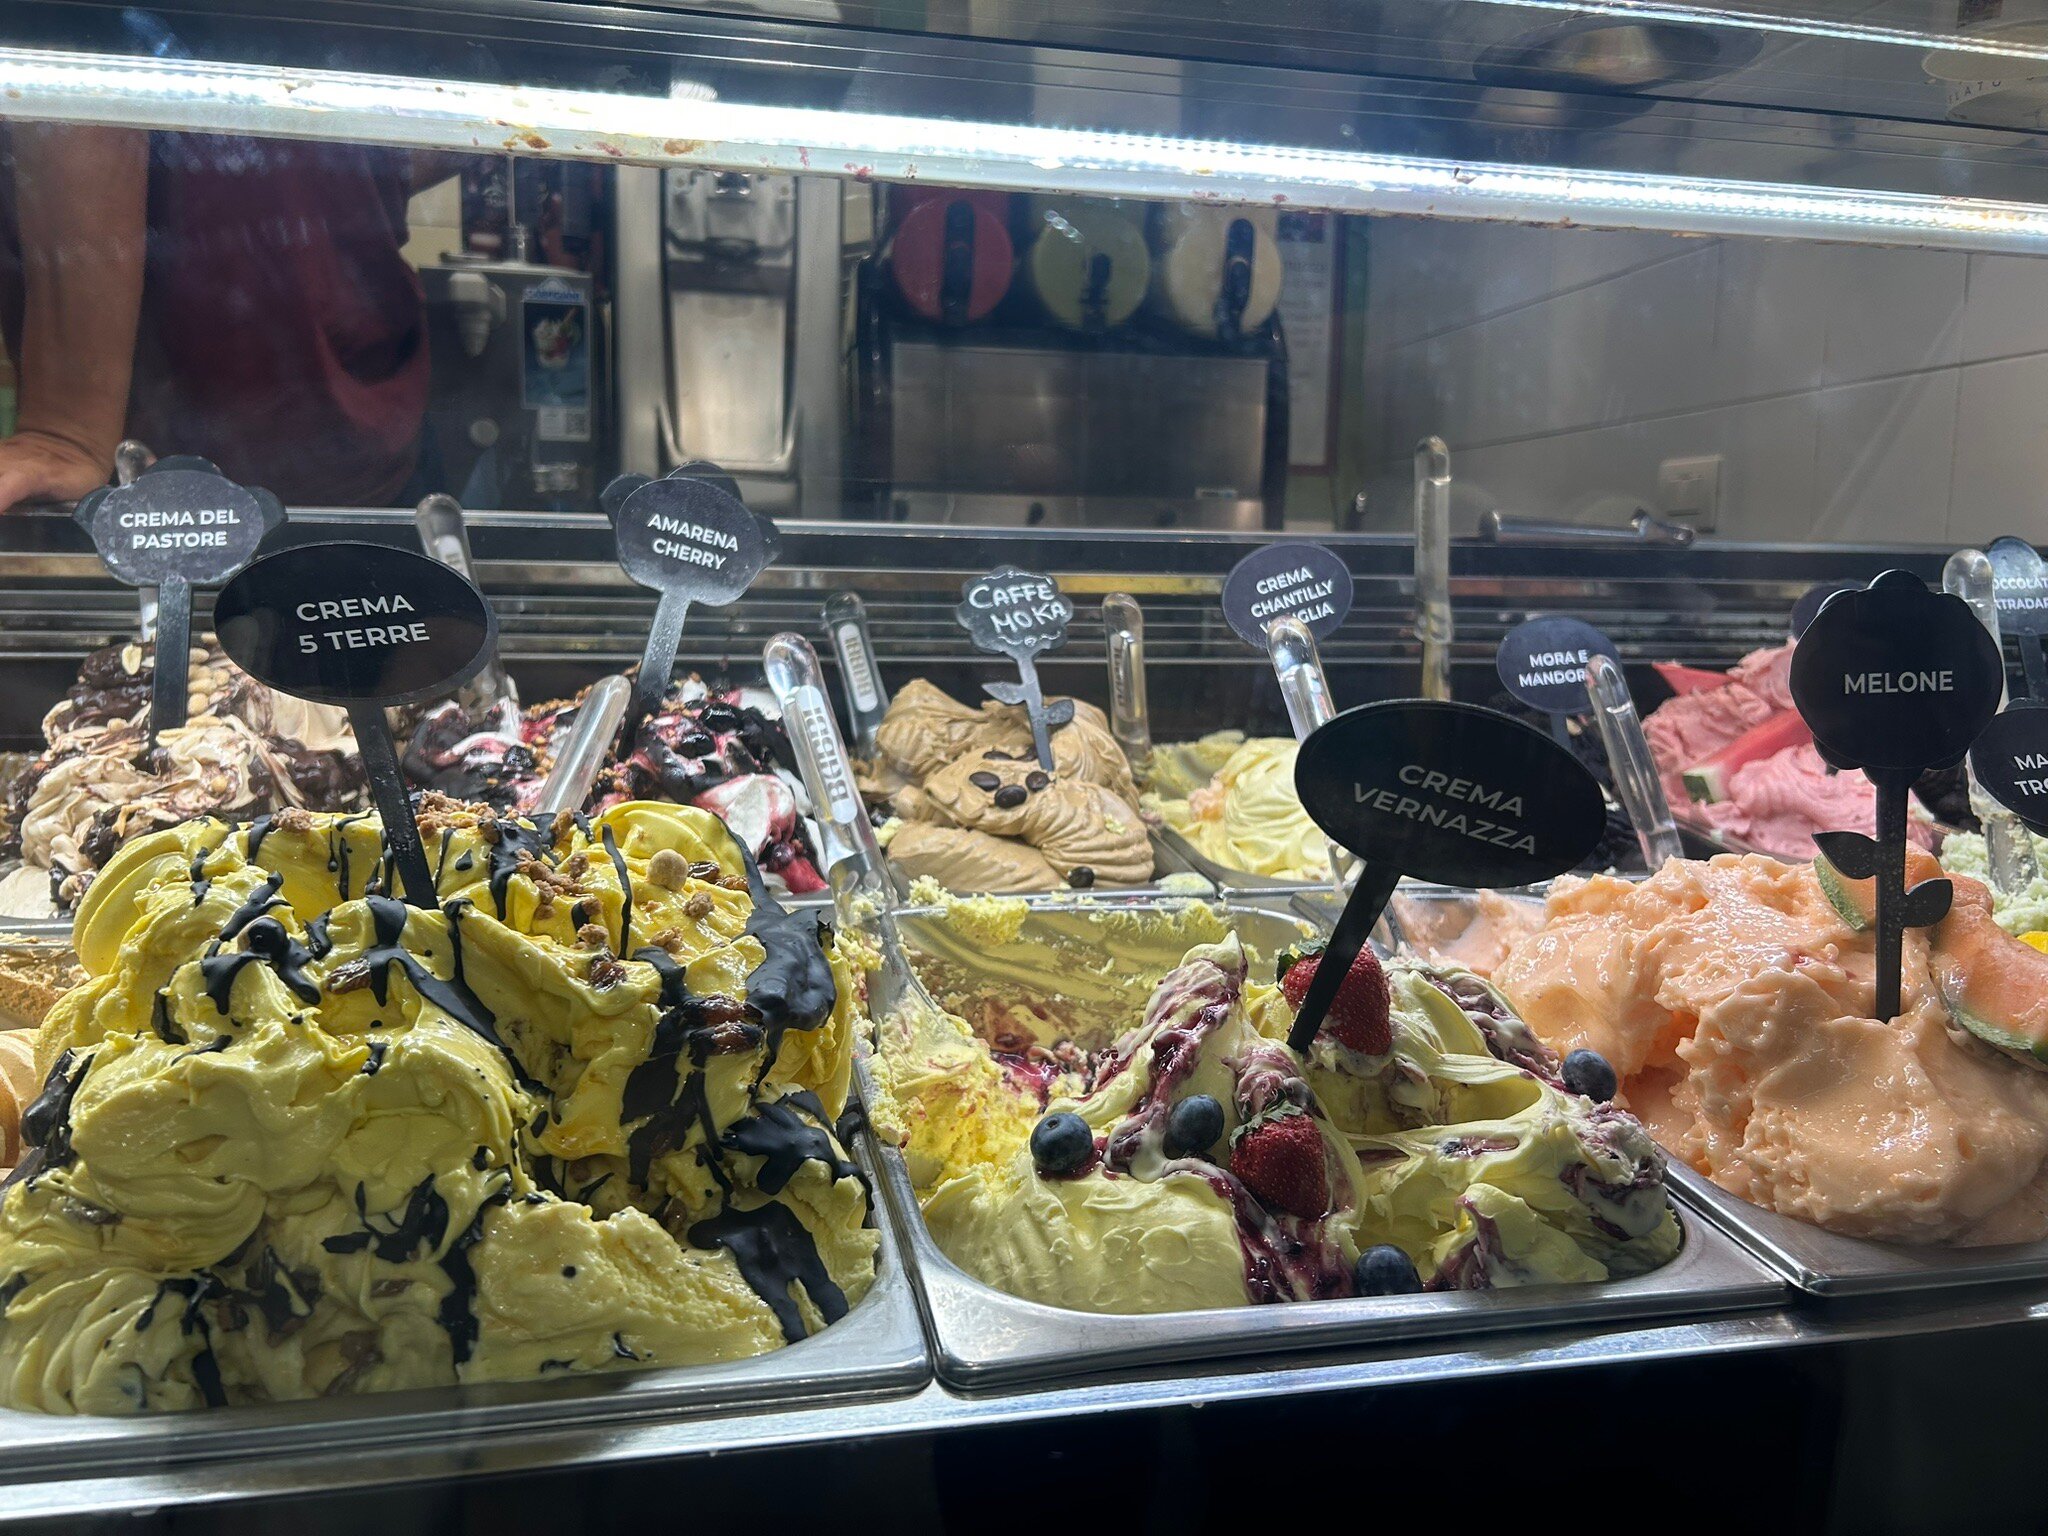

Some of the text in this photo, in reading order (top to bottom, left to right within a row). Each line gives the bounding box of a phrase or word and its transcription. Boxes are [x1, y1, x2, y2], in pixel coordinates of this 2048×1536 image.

[119, 509, 240, 528] CREMA DEL
[647, 513, 739, 552] AMARENA
[132, 531, 228, 550] PASTORE
[653, 538, 727, 570] CHERRY
[1256, 565, 1313, 594] CREMA
[1993, 575, 2048, 590] OCCOLAT
[296, 594, 415, 622] CREMA
[1250, 578, 1333, 617] CHANTILLY
[990, 601, 1067, 633] MOKA
[1260, 601, 1335, 634] VGLIA
[299, 622, 430, 654] 5 TERRE
[1529, 649, 1589, 668] MORA E
[1518, 668, 1587, 688] MANDOR
[1844, 670, 1954, 695] MELONE
[2013, 753, 2048, 771] MA
[1398, 764, 1523, 818] CREMA
[1353, 782, 1536, 855] VERNAZZA
